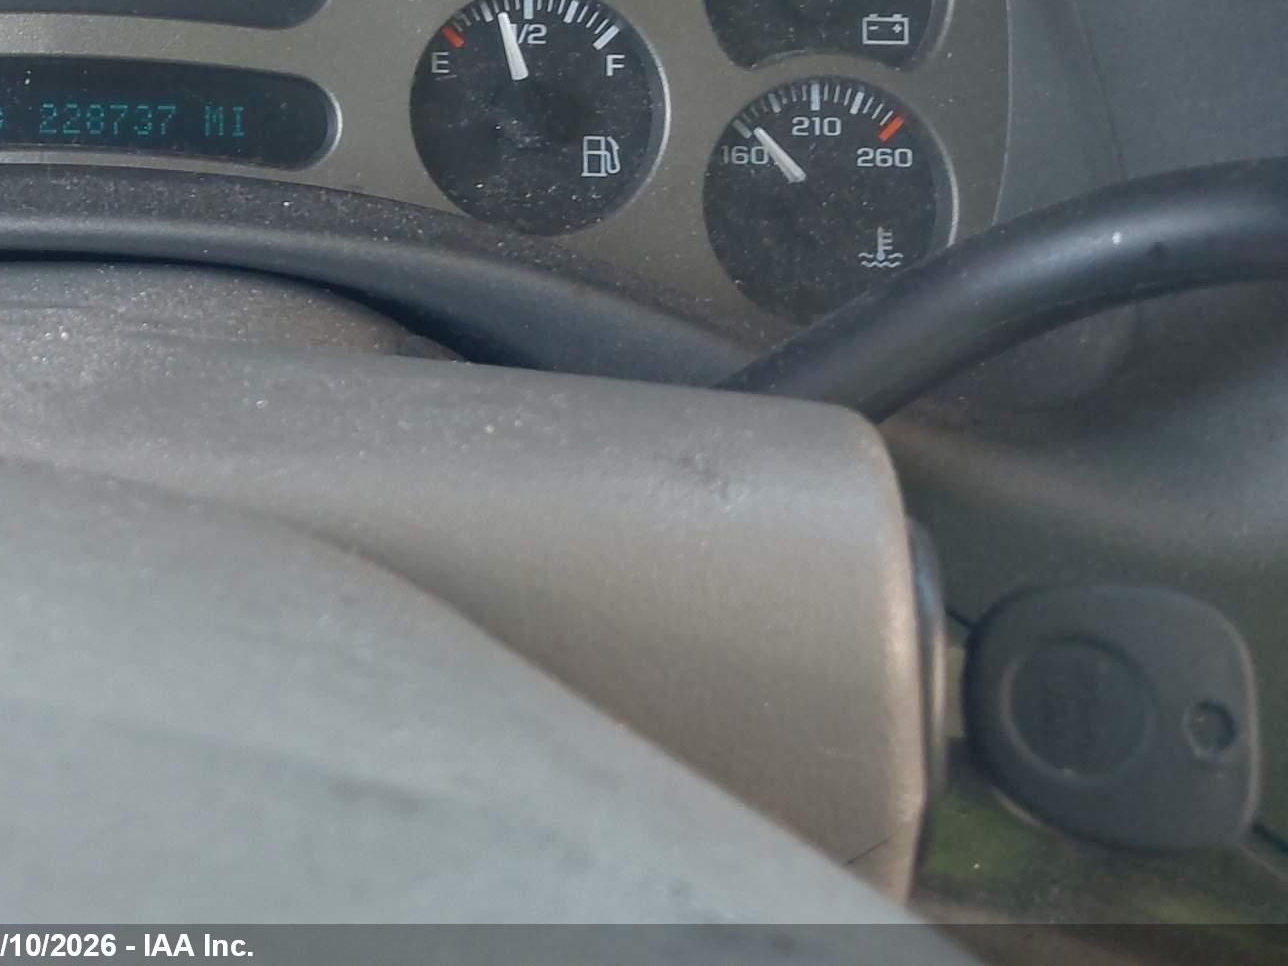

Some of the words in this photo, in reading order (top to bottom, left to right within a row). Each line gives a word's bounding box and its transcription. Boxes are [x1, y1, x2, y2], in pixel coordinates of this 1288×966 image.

[431, 51, 450, 74] E
[606, 54, 625, 77] F
[39, 104, 177, 136] 228737
[204, 106, 245, 137] MI
[791, 116, 842, 136] 210
[720, 145, 768, 166] 160
[856, 147, 913, 168] 260
